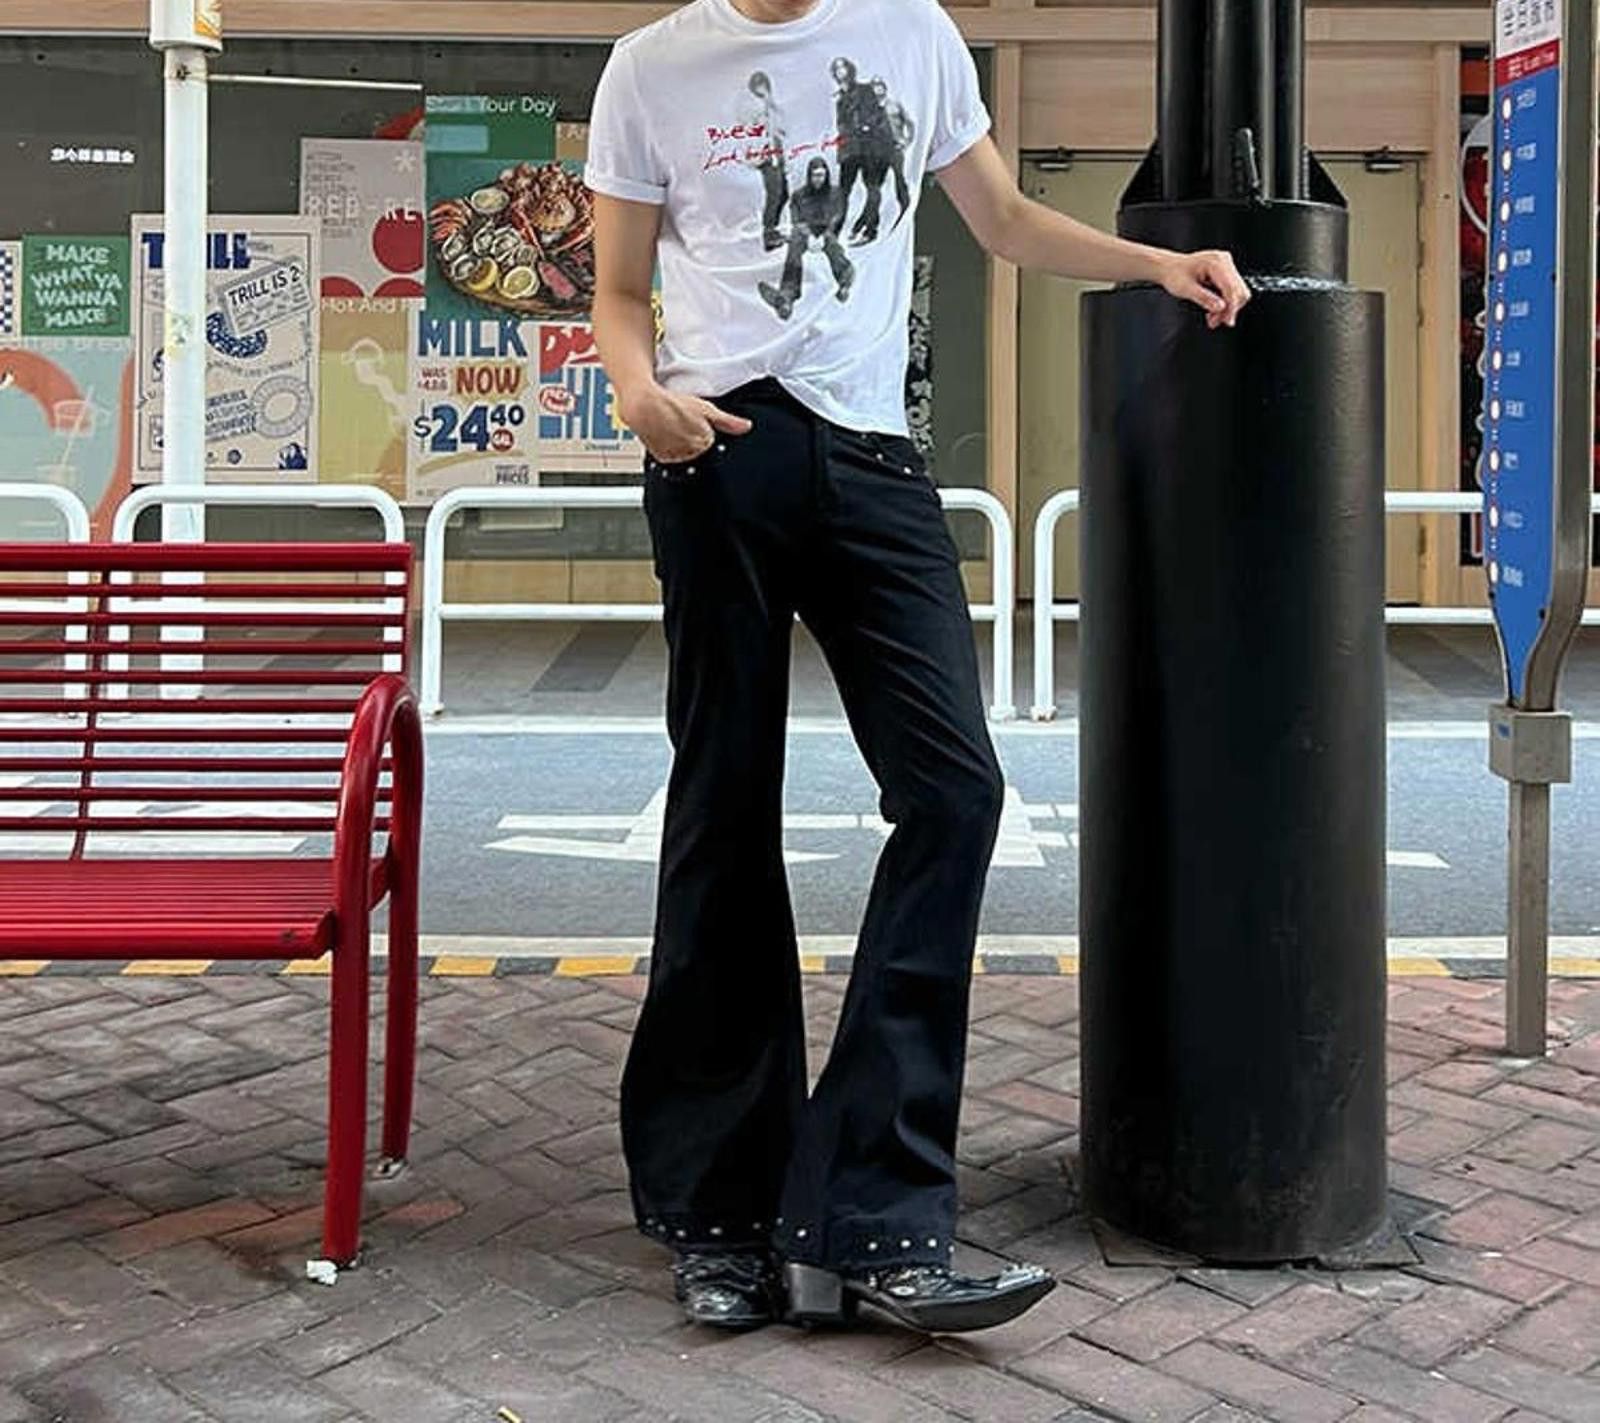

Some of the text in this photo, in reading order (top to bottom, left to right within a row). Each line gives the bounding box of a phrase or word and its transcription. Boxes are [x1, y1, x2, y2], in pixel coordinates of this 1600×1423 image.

[520, 96, 556, 118] Day
[46, 244, 110, 264] MAKE
[31, 264, 123, 291] WHAT YA
[34, 289, 119, 307] WANNA
[227, 277, 271, 308] TRILL
[271, 272, 289, 291] IS
[43, 307, 108, 327] MAKE
[418, 311, 528, 358] MILK
[456, 366, 521, 395] NOW
